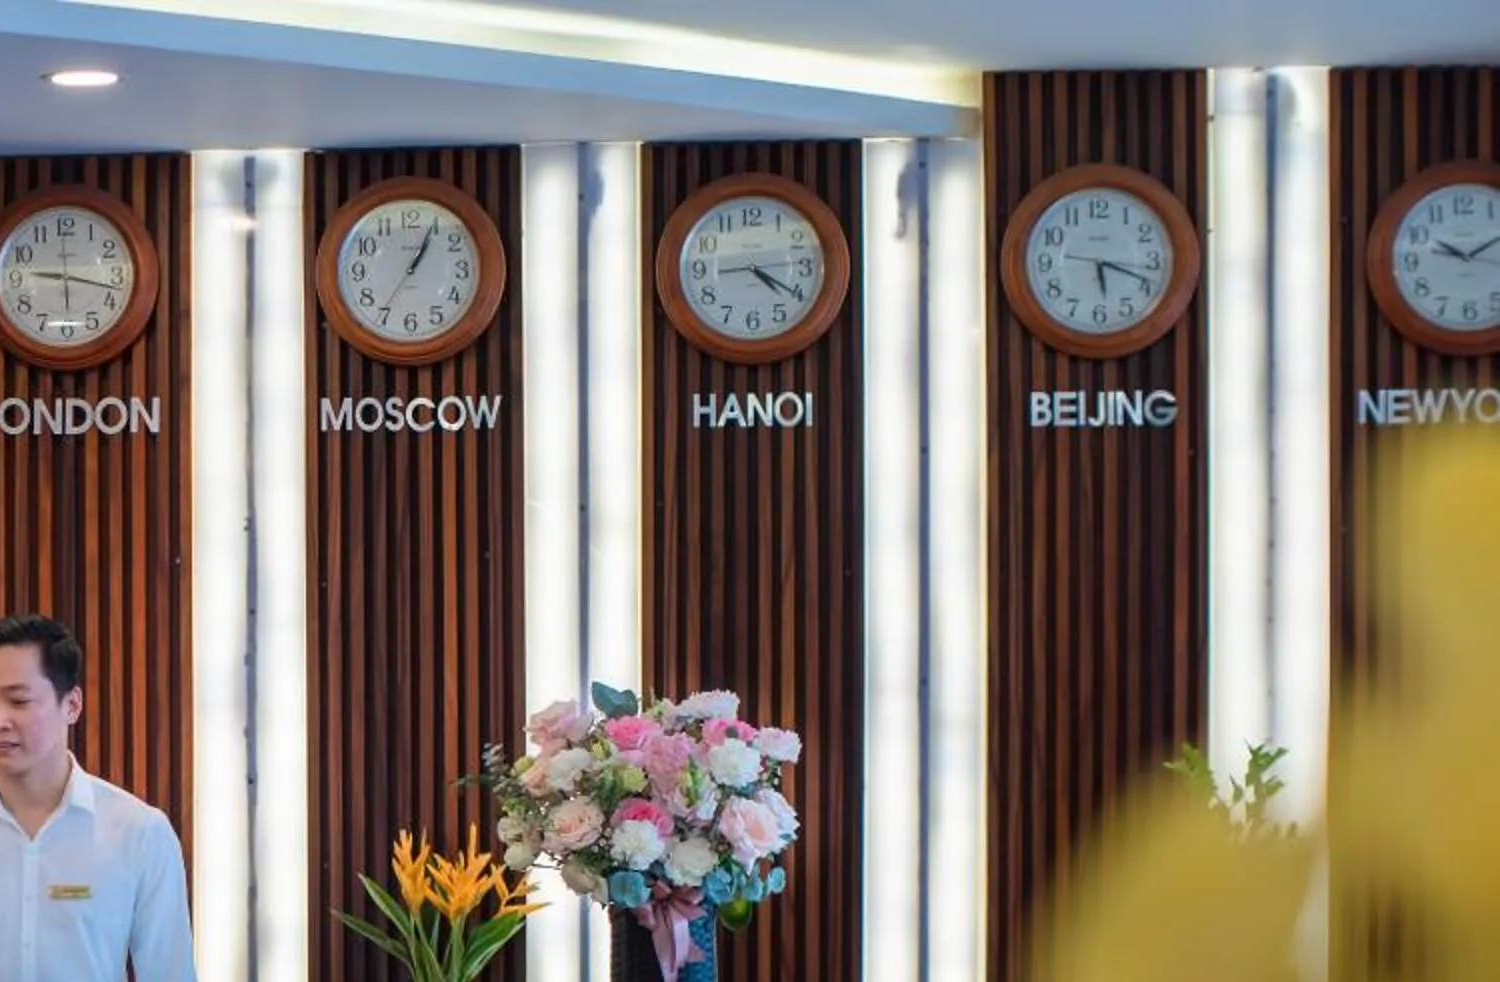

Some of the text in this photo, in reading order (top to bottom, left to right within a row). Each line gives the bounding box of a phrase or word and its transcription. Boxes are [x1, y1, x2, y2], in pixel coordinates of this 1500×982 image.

[1089, 200, 1108, 218] 12
[1430, 205, 1443, 223] 11
[1454, 196, 1474, 215] 12
[402, 210, 420, 229] 12
[719, 214, 731, 232] 11
[742, 208, 762, 226] 12
[1066, 207, 1078, 225] 11
[34, 225, 46, 243] 11
[57, 217, 75, 236] 12
[378, 218, 390, 236] 11
[1138, 224, 1151, 242] 2
[1410, 225, 1428, 244] 10
[448, 233, 461, 252] 2
[699, 236, 717, 253] 10
[791, 230, 804, 249] 2
[1045, 227, 1063, 245] 10
[15, 245, 33, 264] 10
[103, 240, 116, 258] 2
[358, 237, 376, 256] 10
[456, 260, 468, 279] 3
[692, 260, 706, 279] 9
[799, 258, 812, 277] 3
[1038, 254, 1052, 272] 9
[1146, 252, 1159, 270] 3
[1404, 252, 1419, 272] 9
[10, 270, 22, 288] 9
[111, 267, 123, 286] 3
[352, 262, 365, 281] 9
[447, 286, 459, 304] 4
[701, 287, 716, 305] 8
[1047, 280, 1061, 298] 8
[1414, 277, 1430, 297] 8
[17, 295, 31, 314] 8
[104, 292, 115, 310] 4
[359, 288, 374, 306] 8
[430, 306, 442, 325] 5
[722, 306, 732, 324] 7
[773, 304, 786, 322] 5
[1067, 299, 1078, 317] 7
[1093, 304, 1107, 323] 6
[1119, 298, 1133, 317] 5
[1434, 296, 1450, 317] 7
[1463, 302, 1478, 320] 6
[36, 313, 48, 331] 7
[85, 312, 98, 330] 5
[379, 307, 390, 325] 7
[404, 313, 417, 332] 6
[746, 311, 760, 330] 6
[320, 396, 502, 432] MOSCOW
[693, 392, 813, 428] HANOI
[1031, 390, 1177, 427] BEIJING
